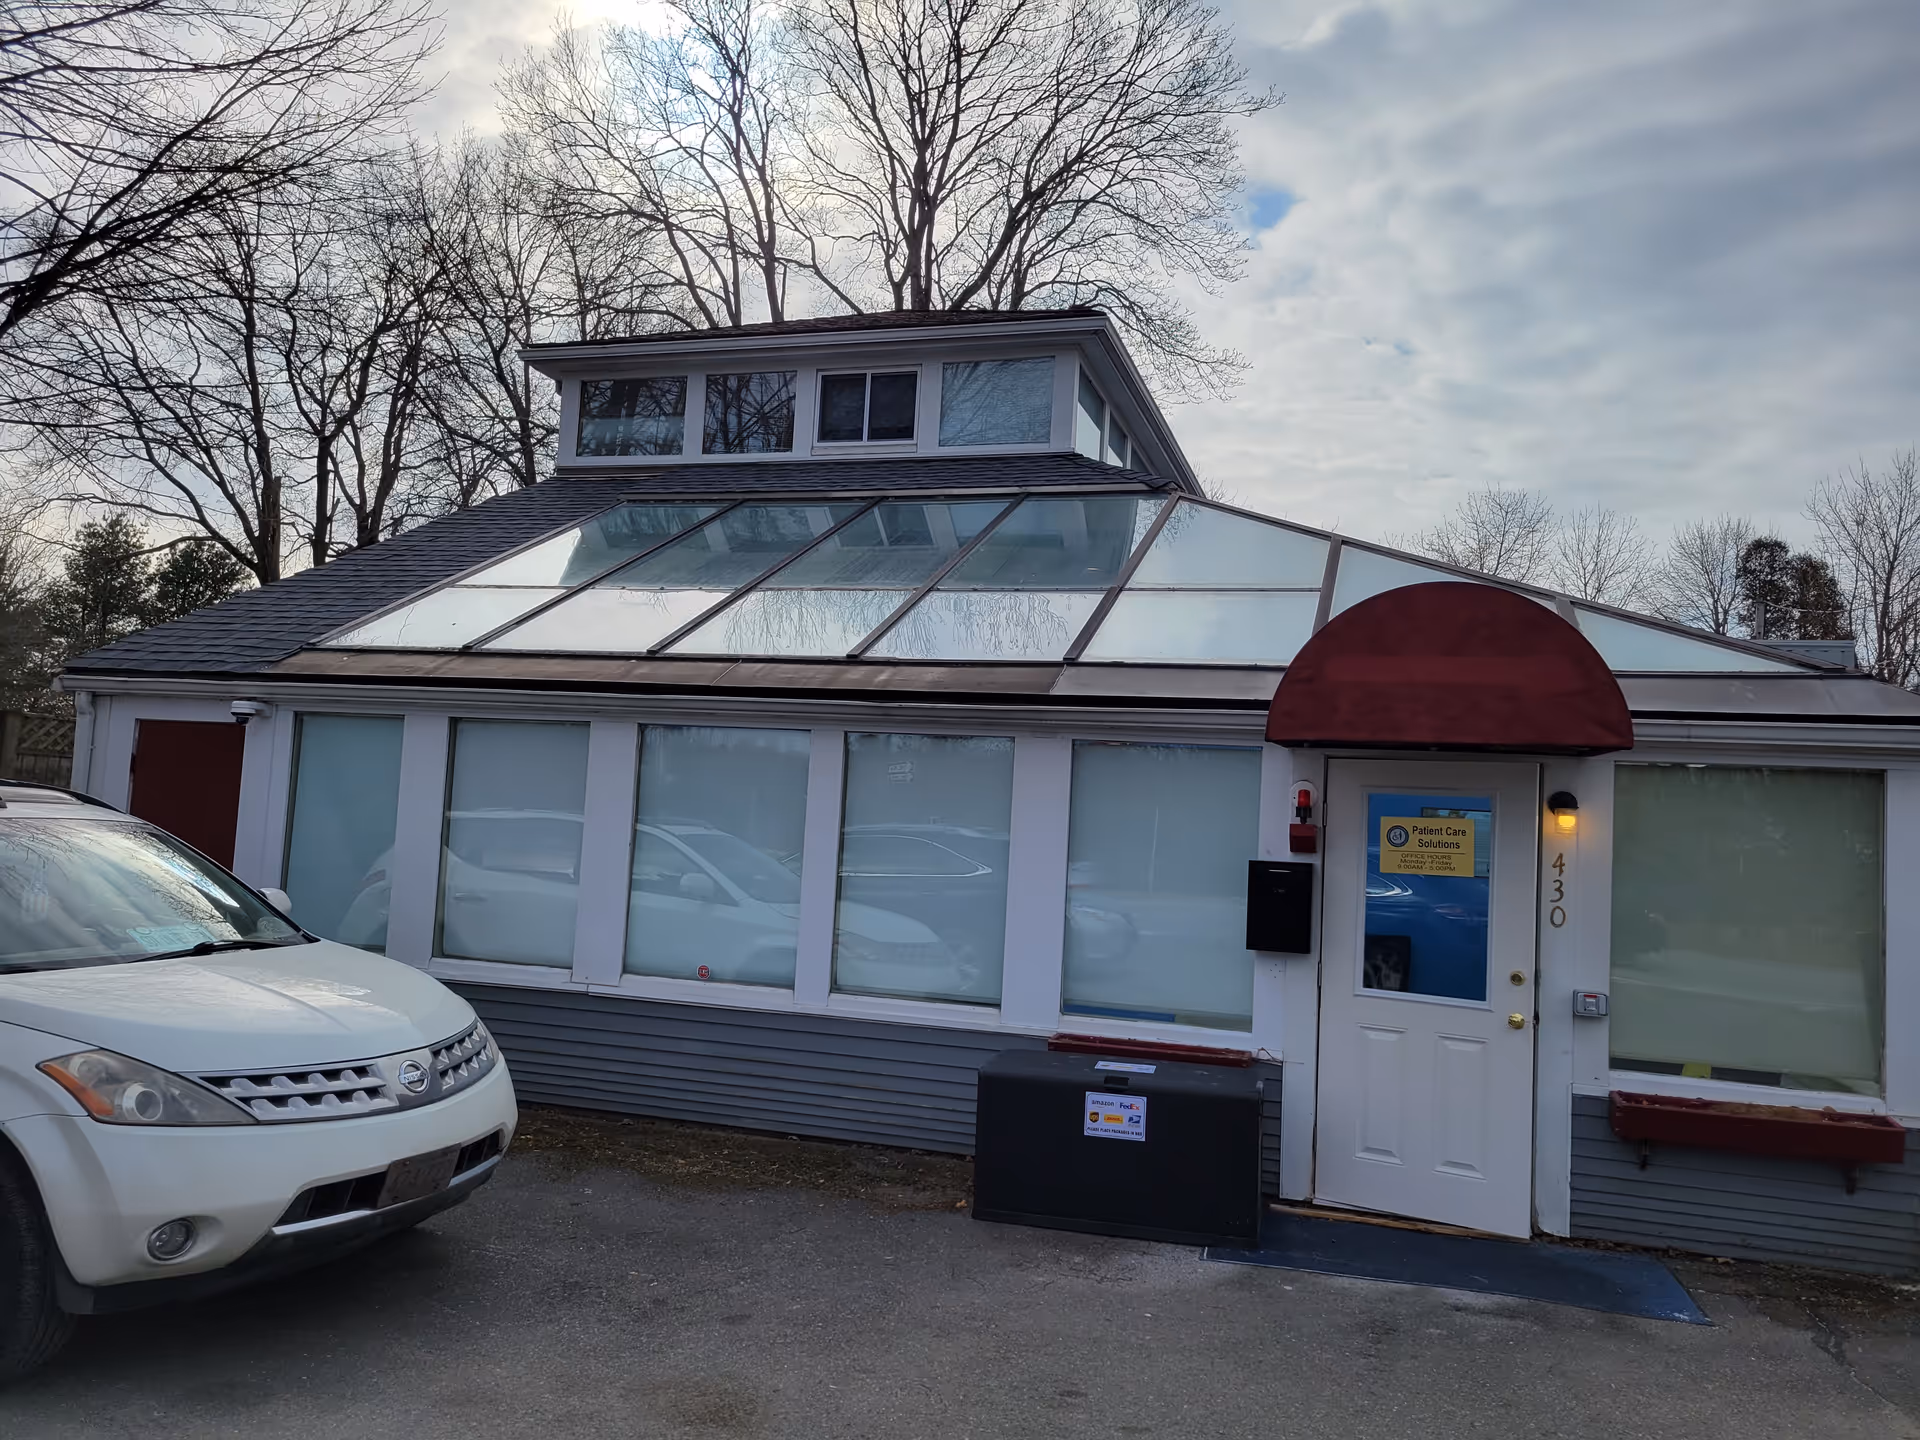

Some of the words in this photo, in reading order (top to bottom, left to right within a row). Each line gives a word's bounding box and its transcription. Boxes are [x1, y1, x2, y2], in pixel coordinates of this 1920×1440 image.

[1412, 825, 1443, 836] Patient
[1445, 827, 1467, 837] Care
[1418, 838, 1460, 849] Solutions
[1119, 1102, 1140, 1111] FedEx
